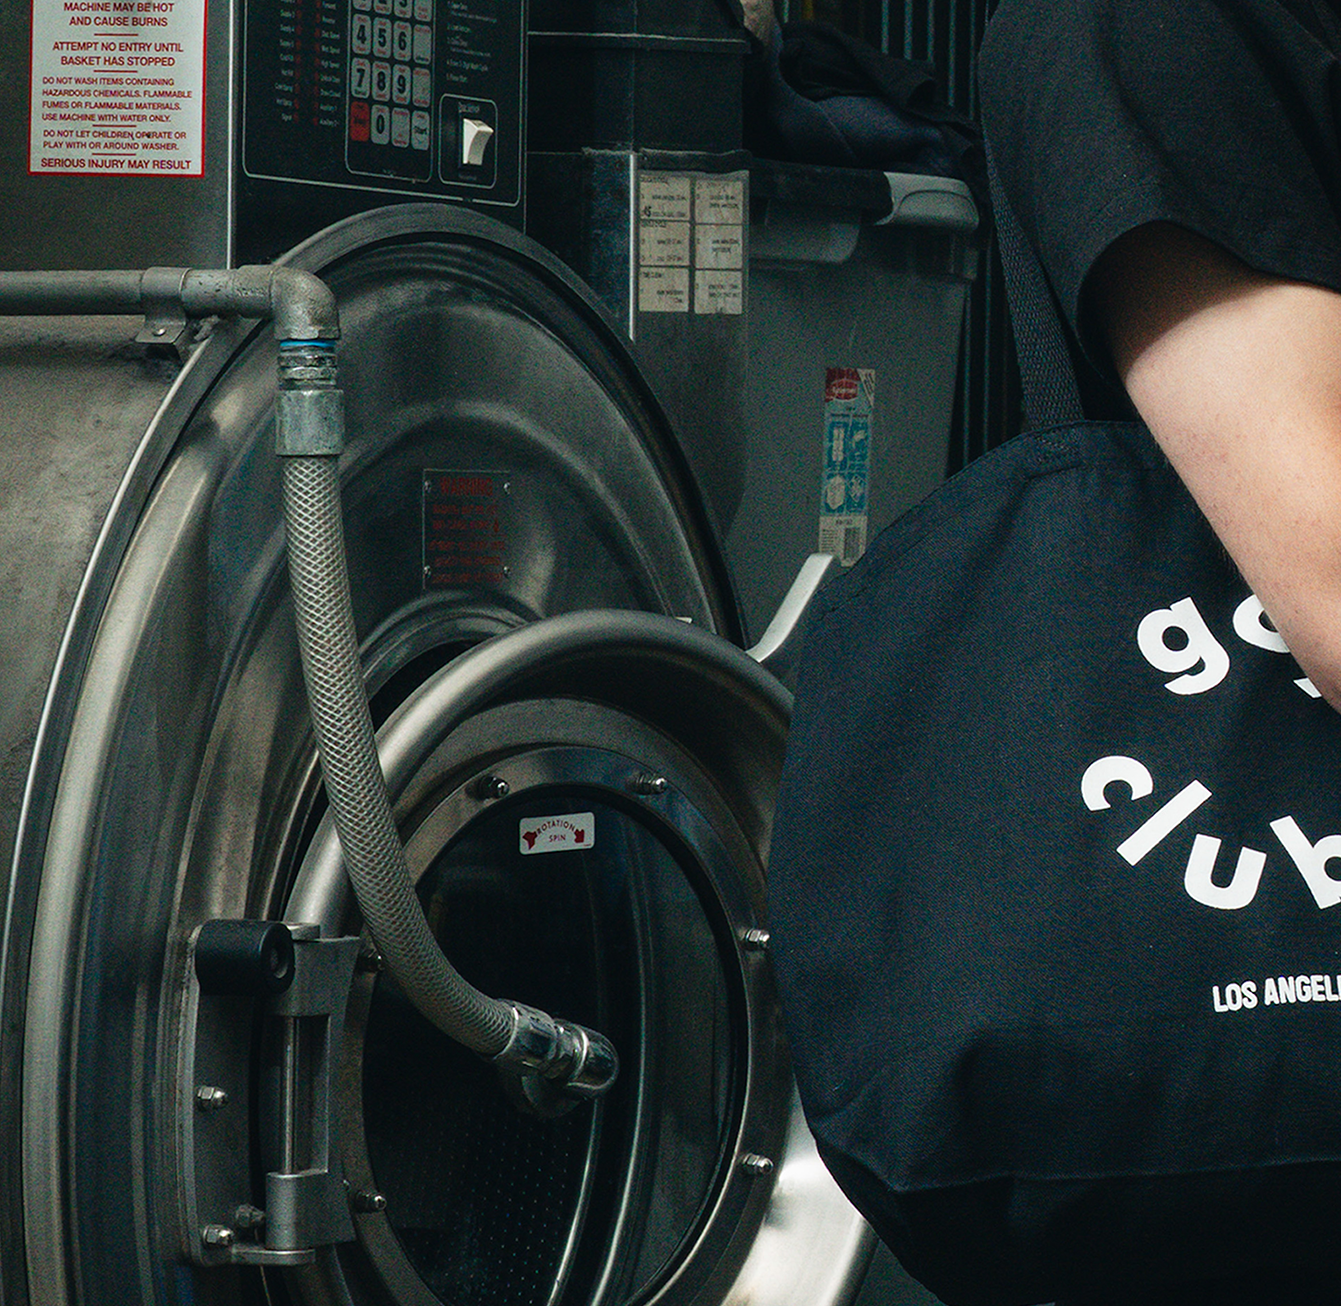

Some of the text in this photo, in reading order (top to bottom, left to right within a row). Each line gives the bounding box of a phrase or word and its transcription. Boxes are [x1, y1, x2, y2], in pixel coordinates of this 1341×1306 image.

[63, 2, 175, 13] MACHINE MAY BE HOT
[69, 16, 168, 27] AND CAUSE BURNS
[356, 25, 407, 51] 4 5 6
[52, 41, 184, 52] ATTEMPT NO ENTRY UNTIL
[60, 56, 175, 66] BASKET HAS STOPPED
[42, 77, 175, 86] DO NOT WASH ITEMS CONTAINING
[356, 68, 406, 94] 7 8 9
[42, 89, 91, 97] HAZARDOUS
[143, 90, 193, 99] FLAMMABLE
[42, 101, 182, 111] FUMES OR FLAMMABLE MATERIALS.
[41, 113, 172, 123] USE MACHINE WITH WATER ONLY.
[376, 114, 386, 134] 0
[43, 129, 187, 140] DO NOT LET CHILDREN OPERATE OR
[43, 141, 180, 151] PLAY WITH OR AROUND WASHER.
[41, 157, 192, 170] SERIOUS INJURY MAY RESULT
[440, 476, 493, 496] WARNING
[537, 819, 576, 835] ROTATION
[548, 834, 567, 843] SPIN
[1213, 983, 1258, 1013] LOS
